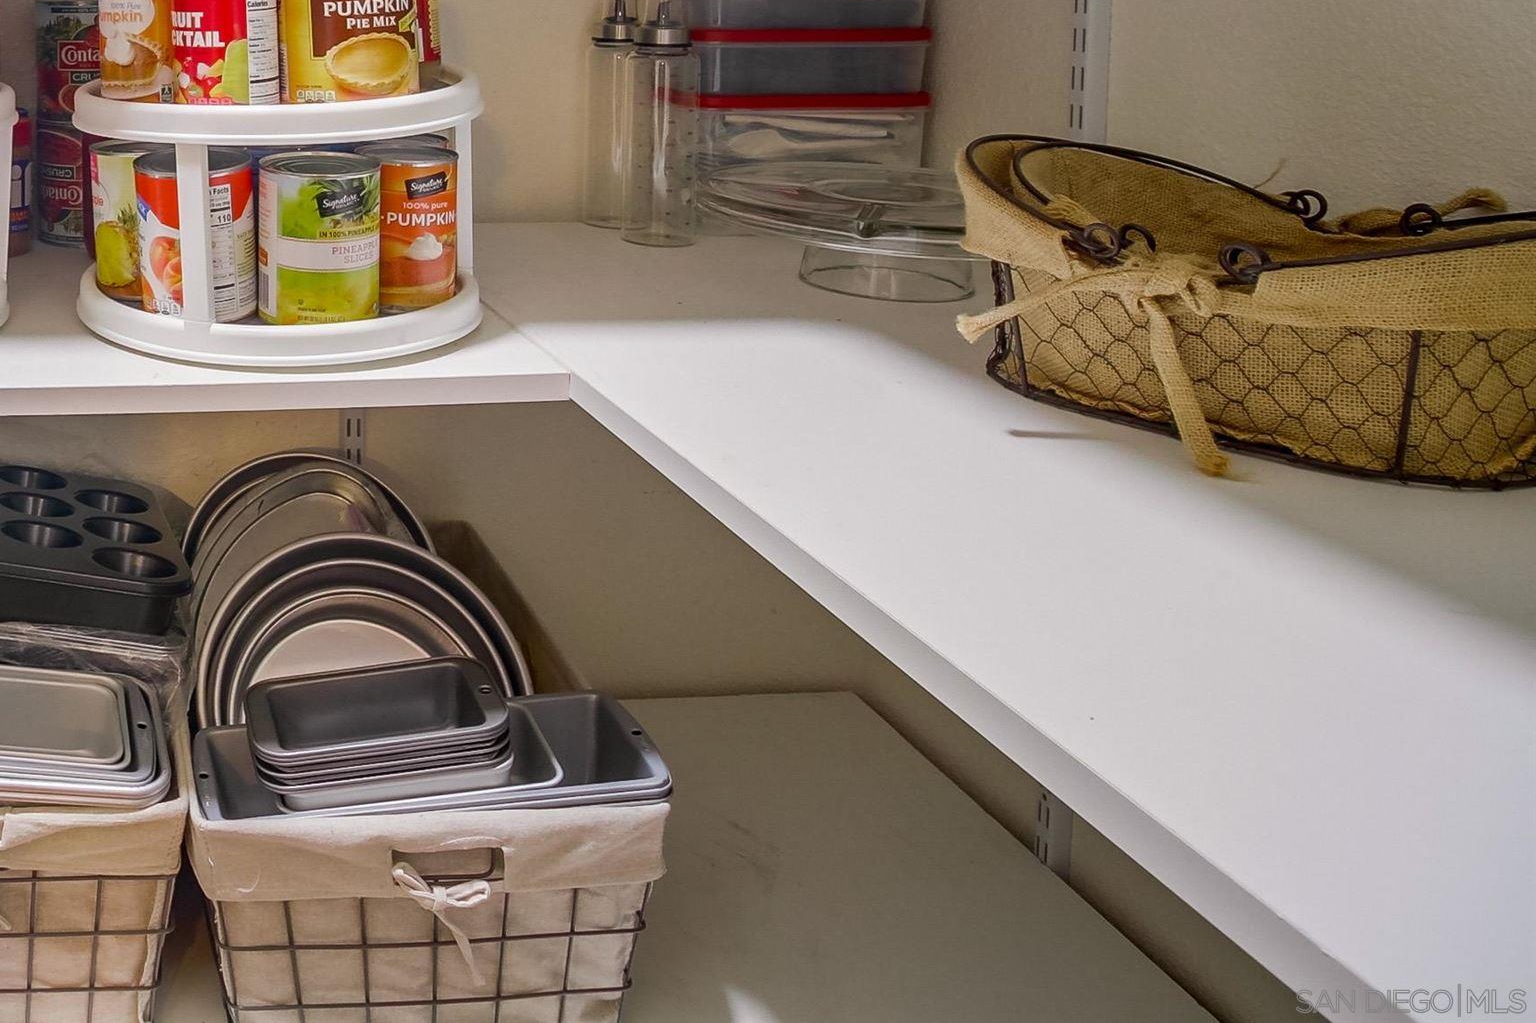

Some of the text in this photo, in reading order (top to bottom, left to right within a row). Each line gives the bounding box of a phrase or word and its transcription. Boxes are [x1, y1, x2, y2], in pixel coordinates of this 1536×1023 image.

[346, 16, 371, 30] PIE
[410, 178, 443, 193] Signature
[322, 193, 358, 209] Signature
[403, 201, 448, 210] 100% pure
[217, 214, 231, 223] 110
[386, 211, 456, 227] PUMPKIN
[344, 251, 374, 264] SLICES
